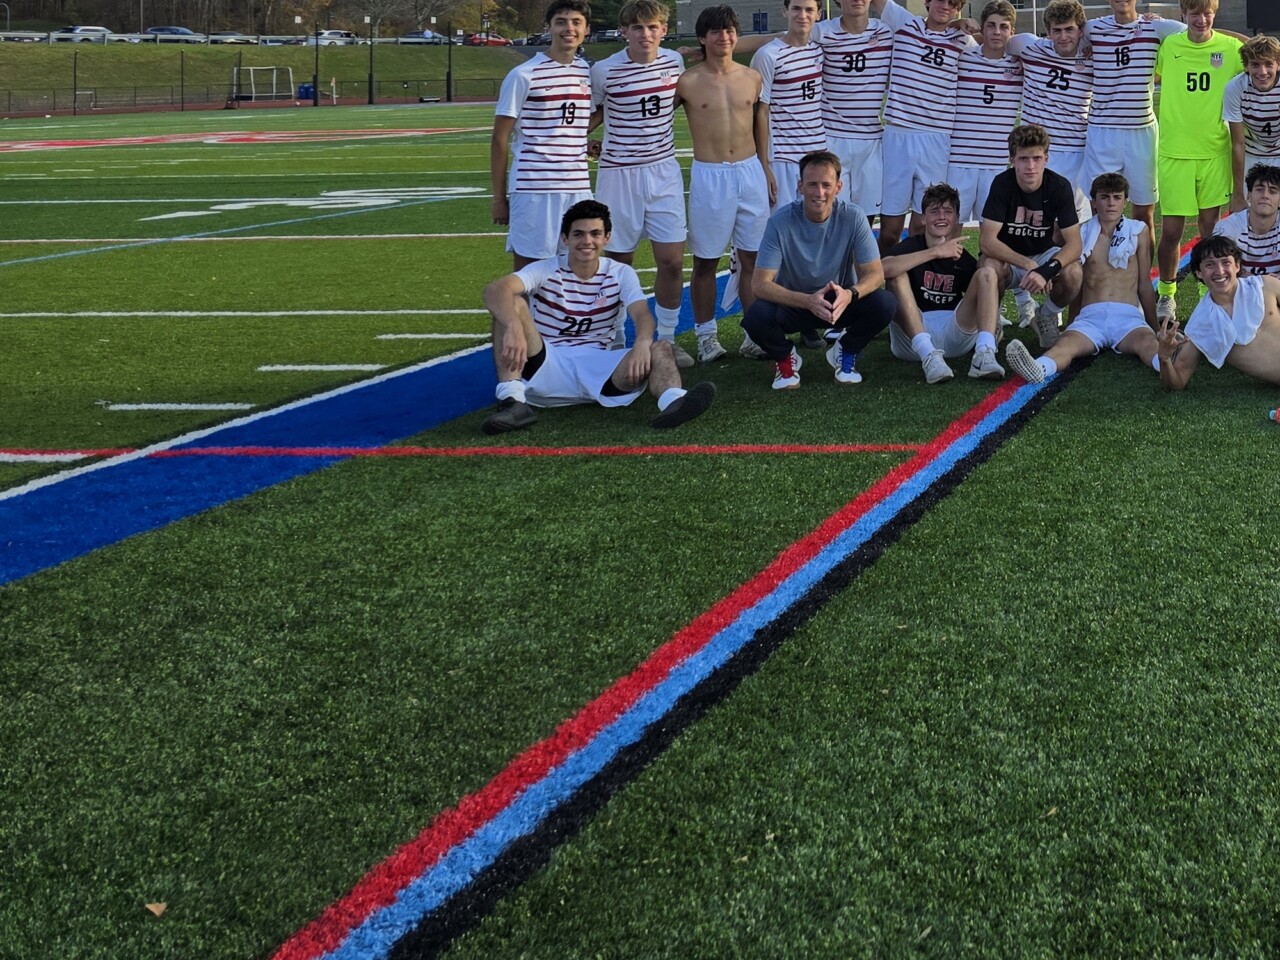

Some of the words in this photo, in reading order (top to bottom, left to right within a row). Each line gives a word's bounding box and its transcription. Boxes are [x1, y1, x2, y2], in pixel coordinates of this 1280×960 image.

[842, 52, 866, 72] 30
[921, 45, 946, 67] 26
[1114, 46, 1130, 67] 16
[801, 80, 816, 100] 15
[1046, 69, 1072, 91] 25
[1187, 72, 1210, 92] 50
[982, 85, 995, 105] 5
[560, 102, 576, 125] 19
[639, 94, 661, 117] 13
[1261, 122, 1272, 135] 4
[1014, 206, 1043, 226] RYE
[1008, 227, 1046, 238] SOCCER
[924, 271, 955, 292] RYE
[559, 316, 592, 336] 20
